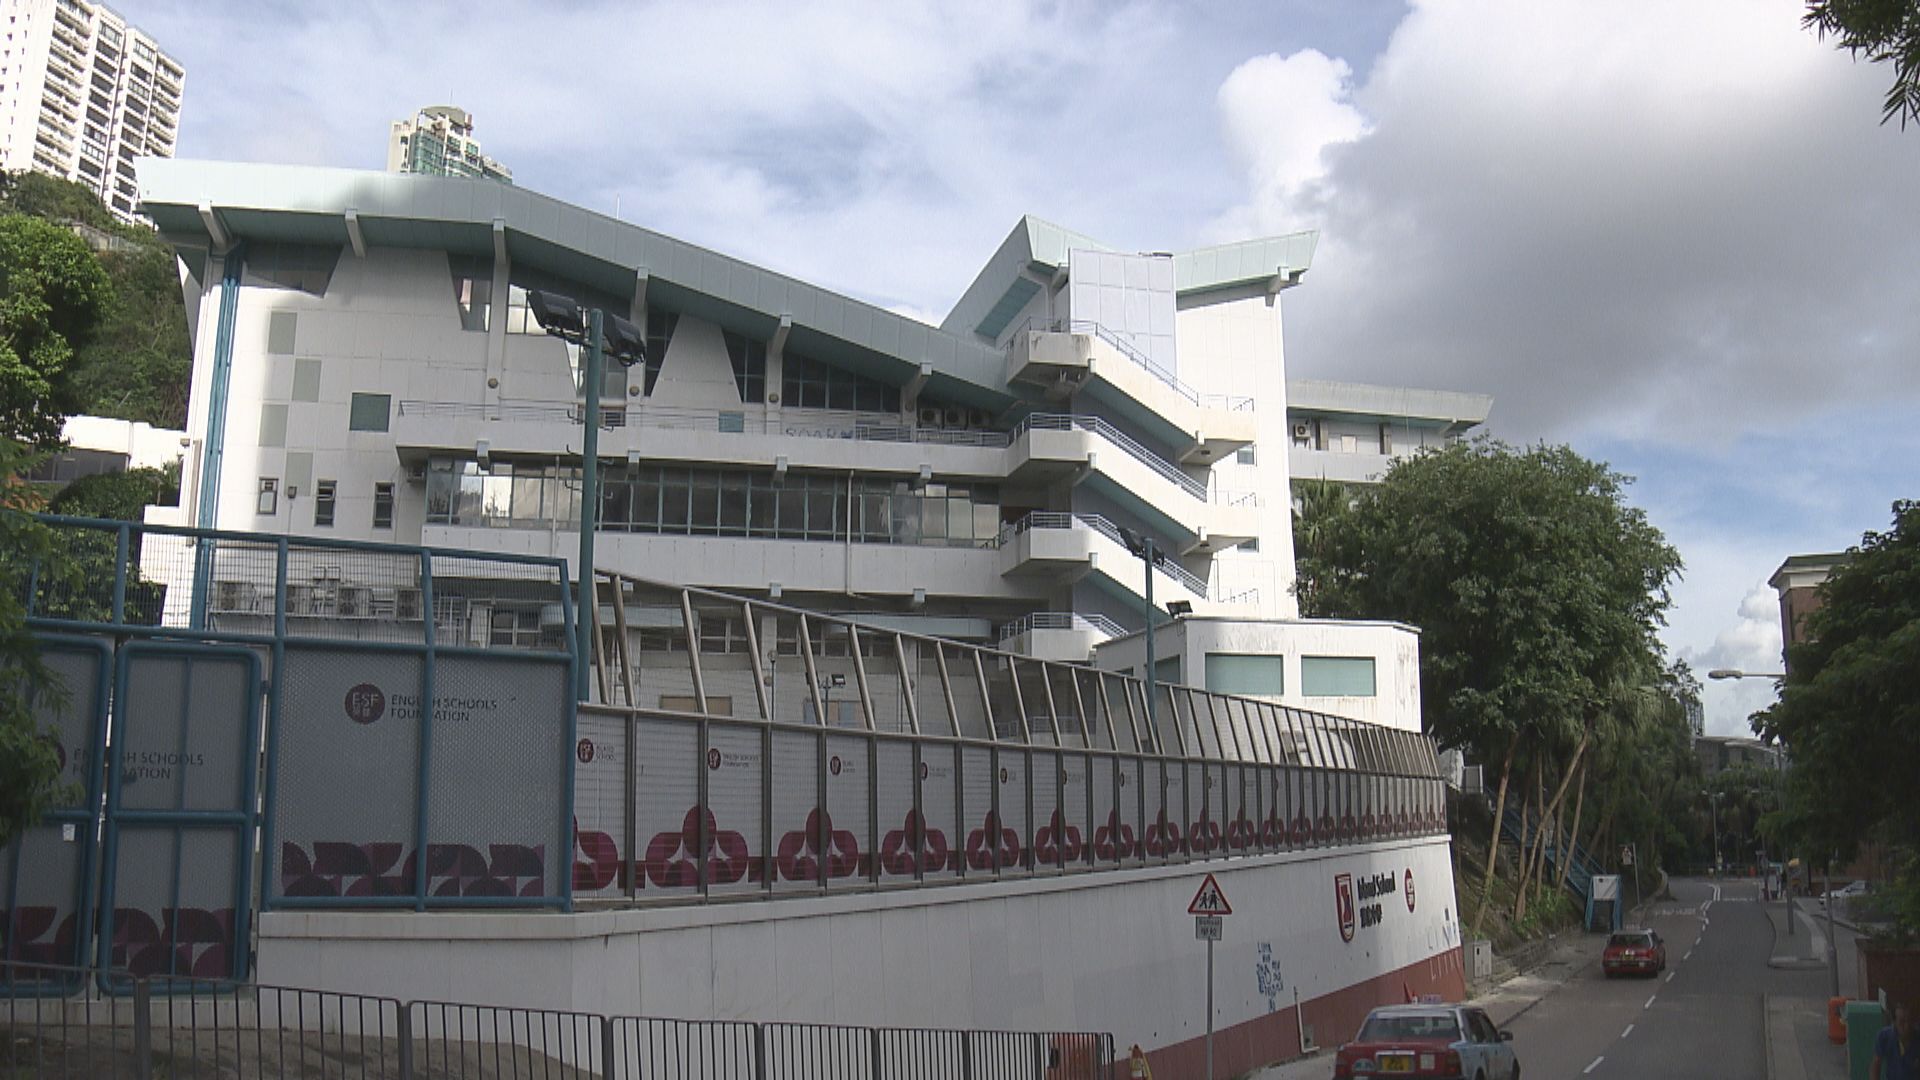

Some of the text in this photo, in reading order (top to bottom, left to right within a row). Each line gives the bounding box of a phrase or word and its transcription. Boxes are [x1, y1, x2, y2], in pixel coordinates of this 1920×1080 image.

[352, 692, 379, 708] ESF
[391, 694, 497, 710] ENGLH SCHOOLS
[391, 708, 470, 721] FOUNATION
[74, 749, 204, 766] ENSH SCHOOLS
[73, 764, 171, 779] FODATION
[1376, 869, 1396, 897] School
